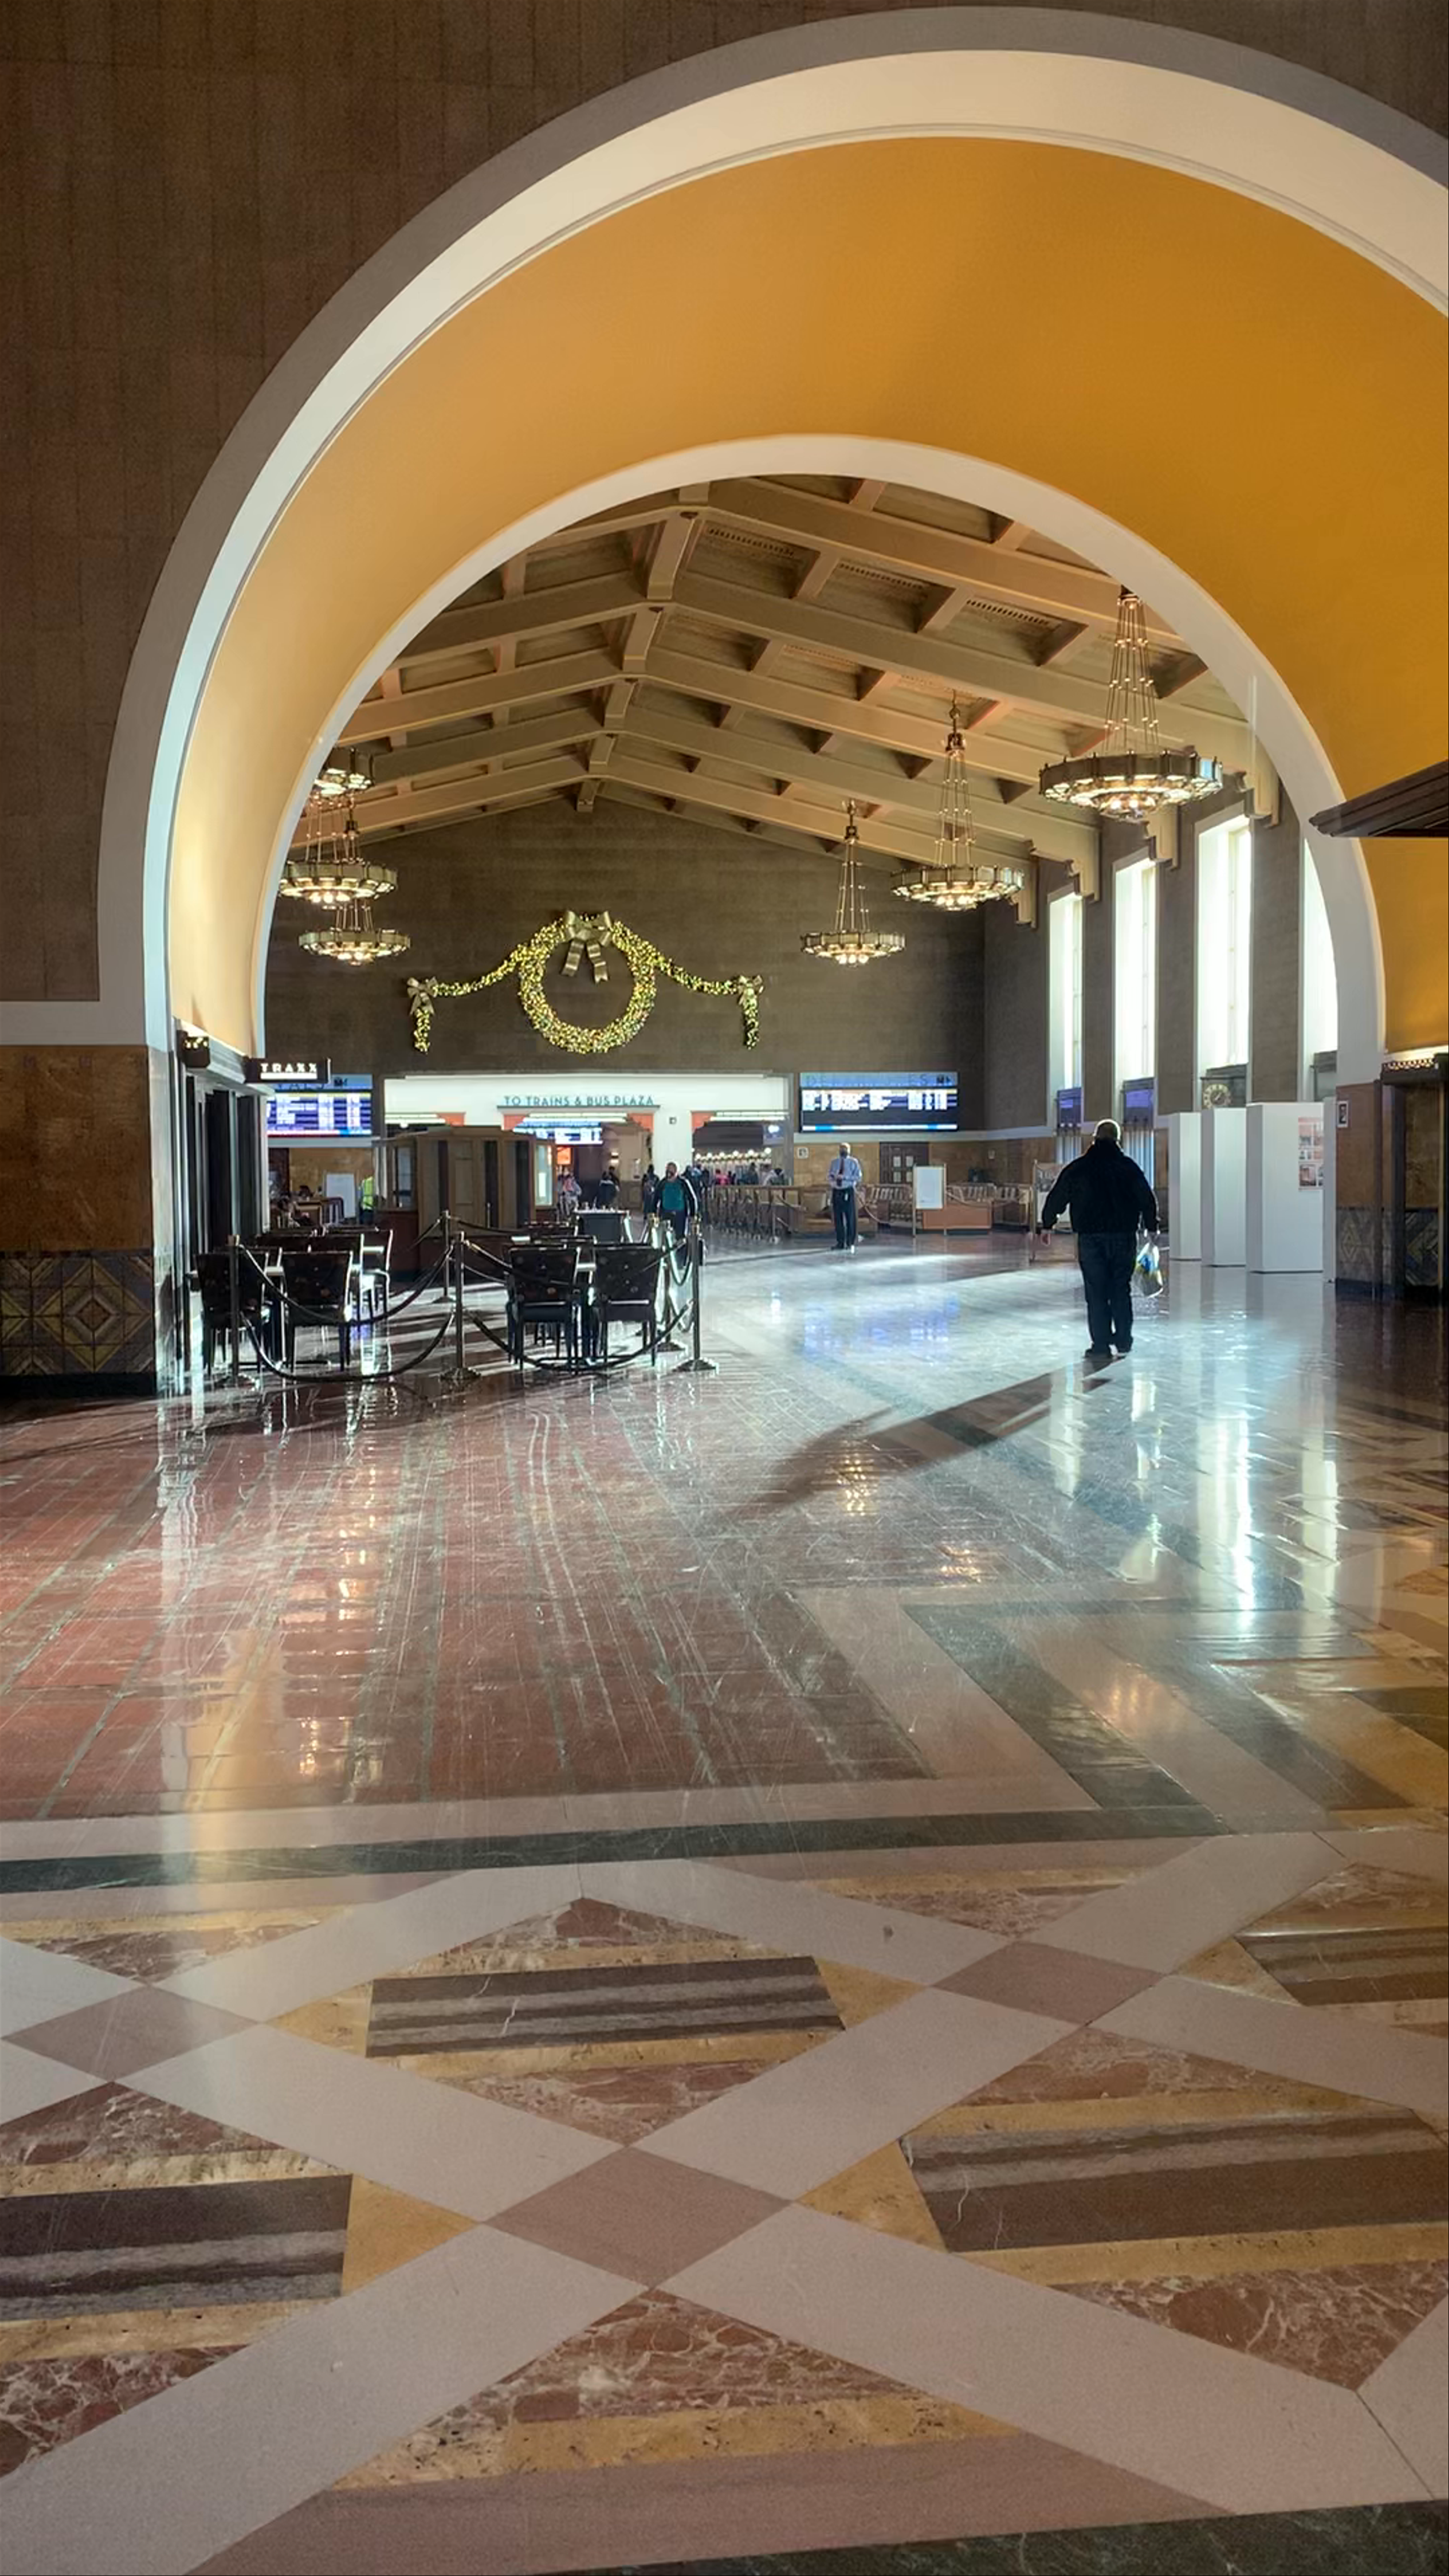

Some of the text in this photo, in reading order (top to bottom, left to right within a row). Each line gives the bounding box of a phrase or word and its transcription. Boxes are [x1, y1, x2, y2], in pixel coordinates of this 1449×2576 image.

[260, 1063, 317, 1073] TRAXX
[504, 1095, 654, 1106] TO TRAINS & BUS PLAZA
